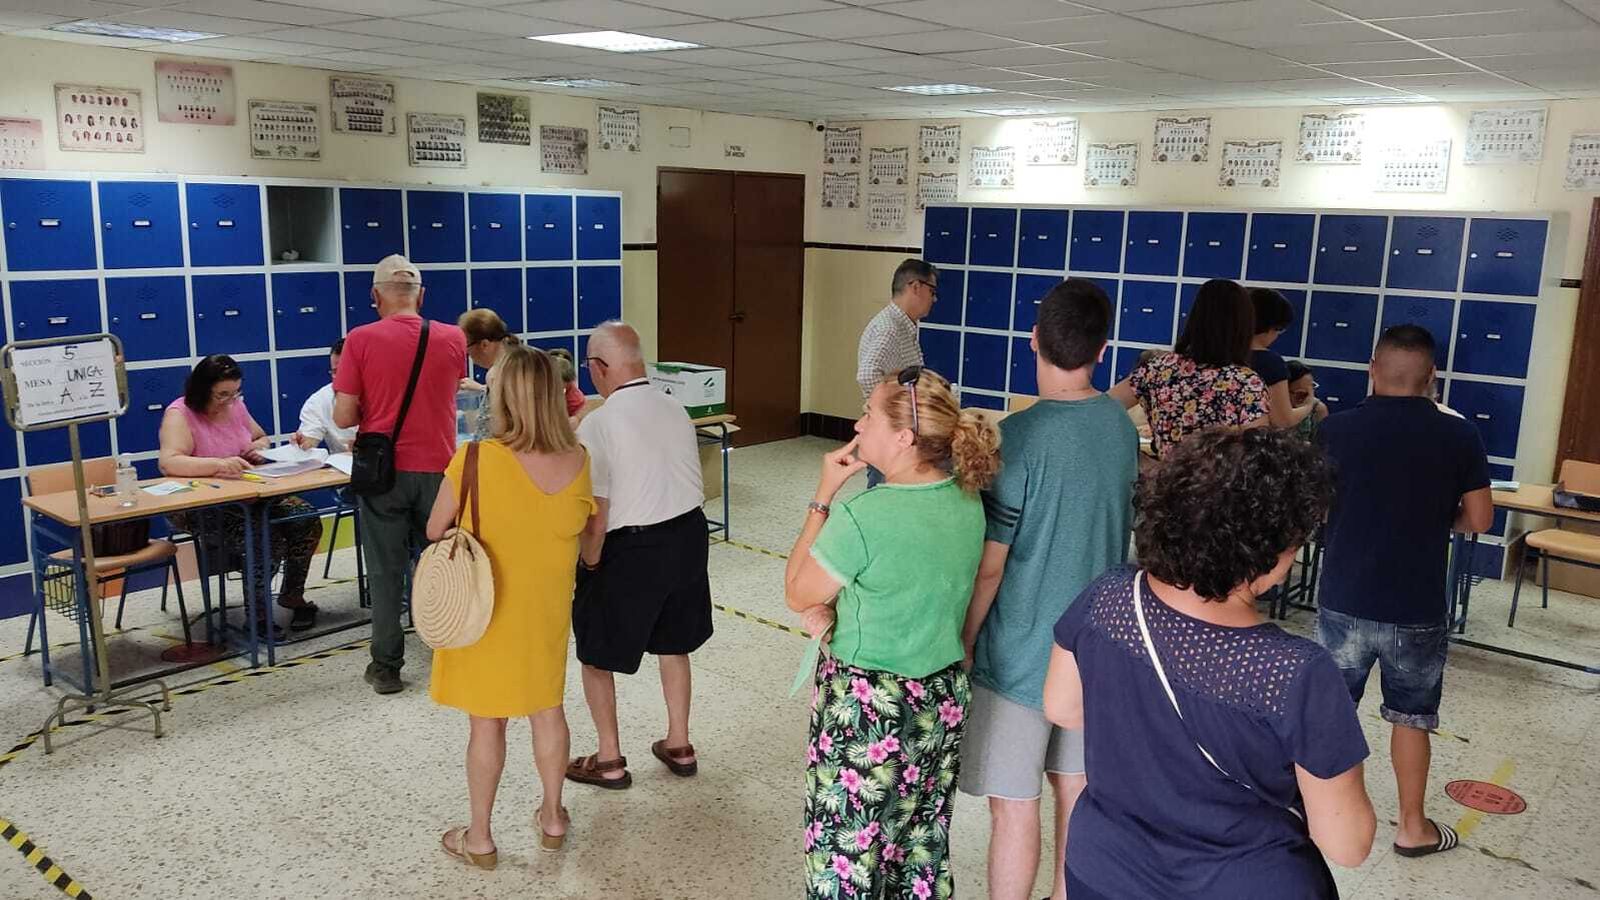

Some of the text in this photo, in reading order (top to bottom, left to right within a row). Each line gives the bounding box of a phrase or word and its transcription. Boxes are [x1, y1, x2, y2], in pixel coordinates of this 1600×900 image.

[63, 345, 78, 360] 5
[24, 378, 52, 391] MESA
[60, 387, 75, 404] A
[89, 382, 105, 397] Z
